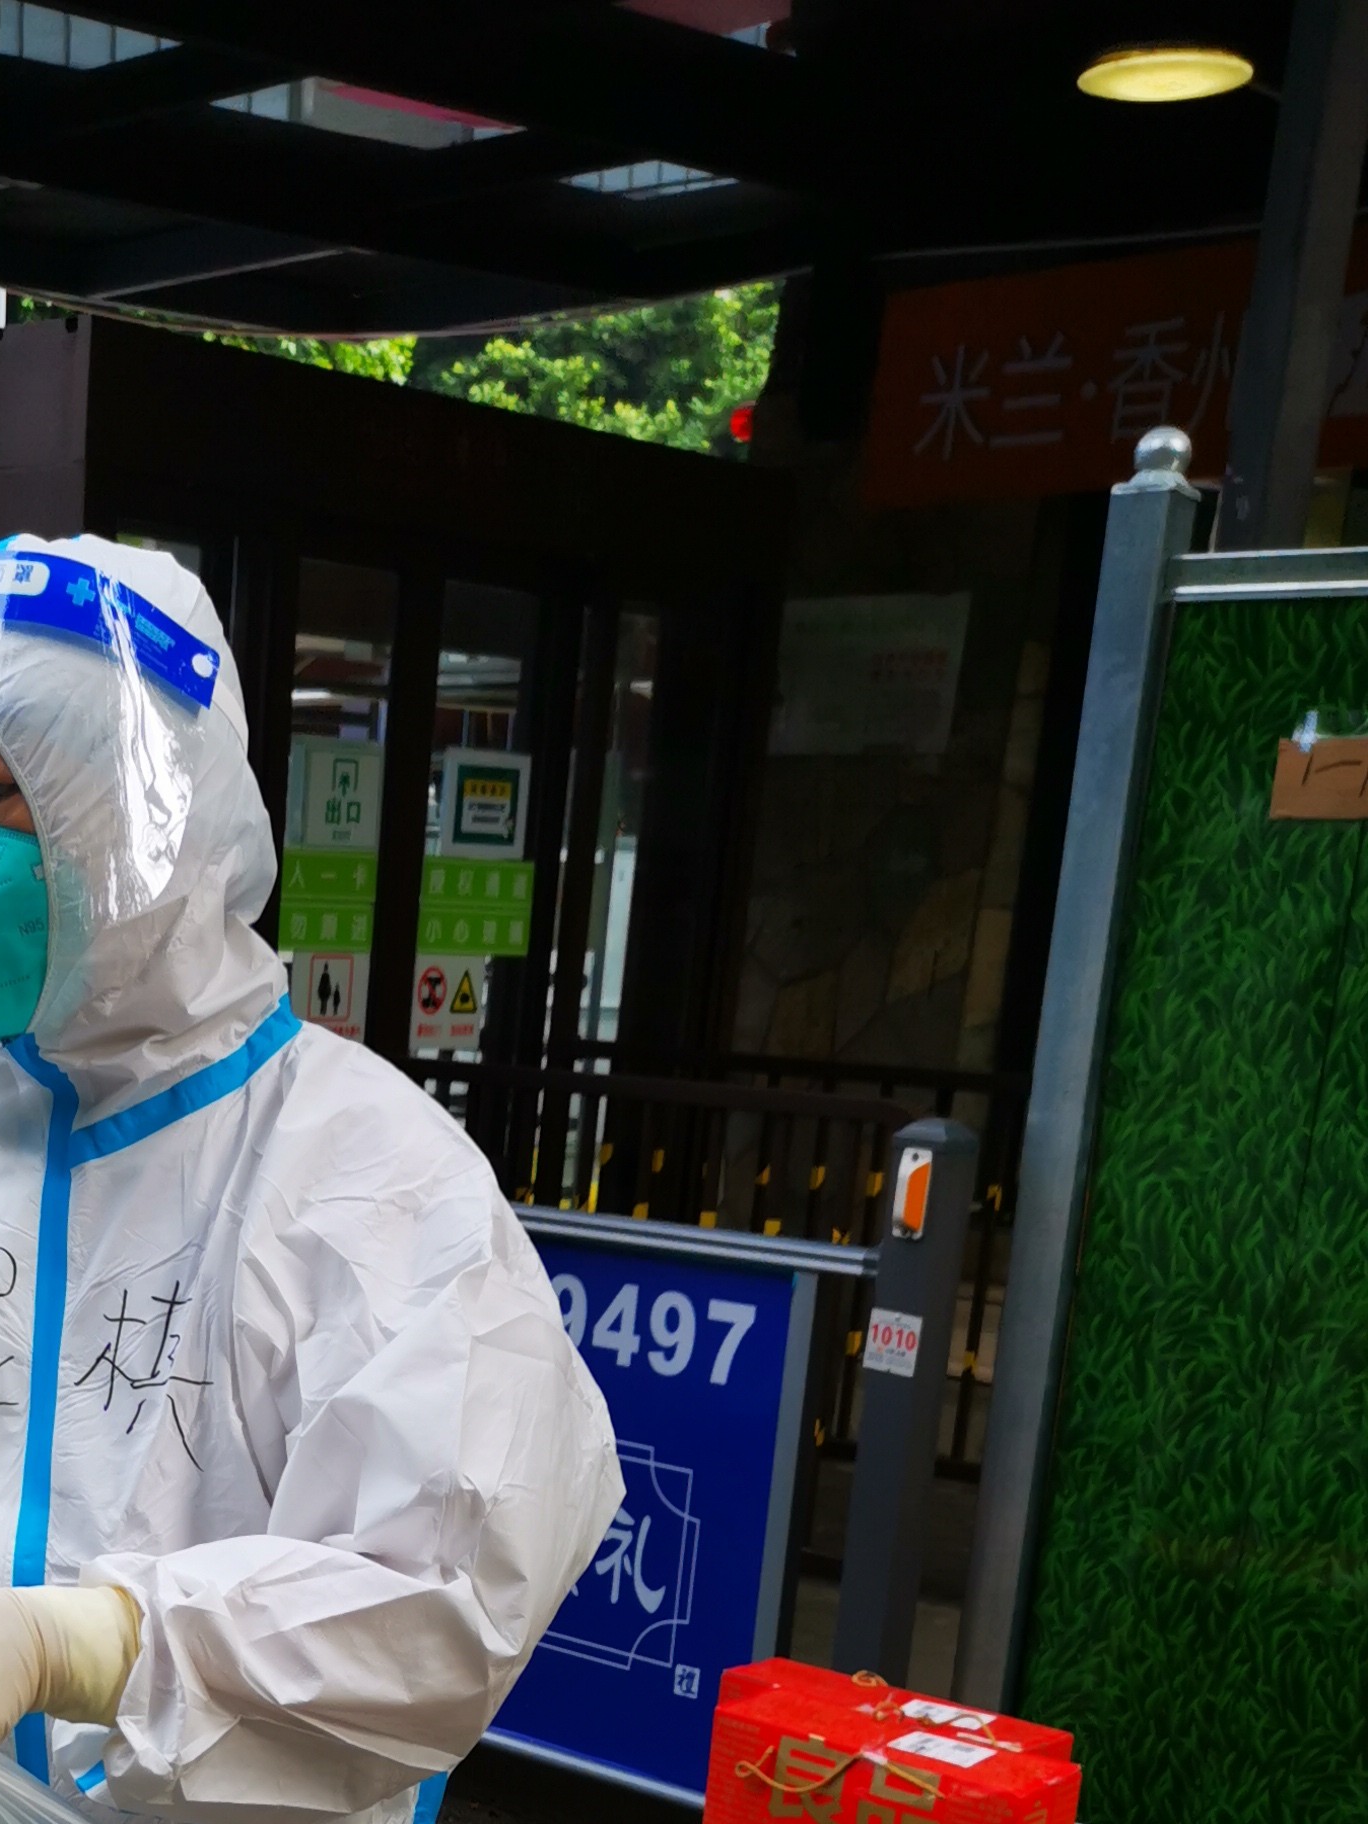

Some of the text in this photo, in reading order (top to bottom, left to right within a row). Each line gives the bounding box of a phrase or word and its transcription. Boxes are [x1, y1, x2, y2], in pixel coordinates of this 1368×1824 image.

[325, 797, 361, 825] 出口
[19, 918, 45, 936] N95
[872, 1323, 917, 1352] 1010
